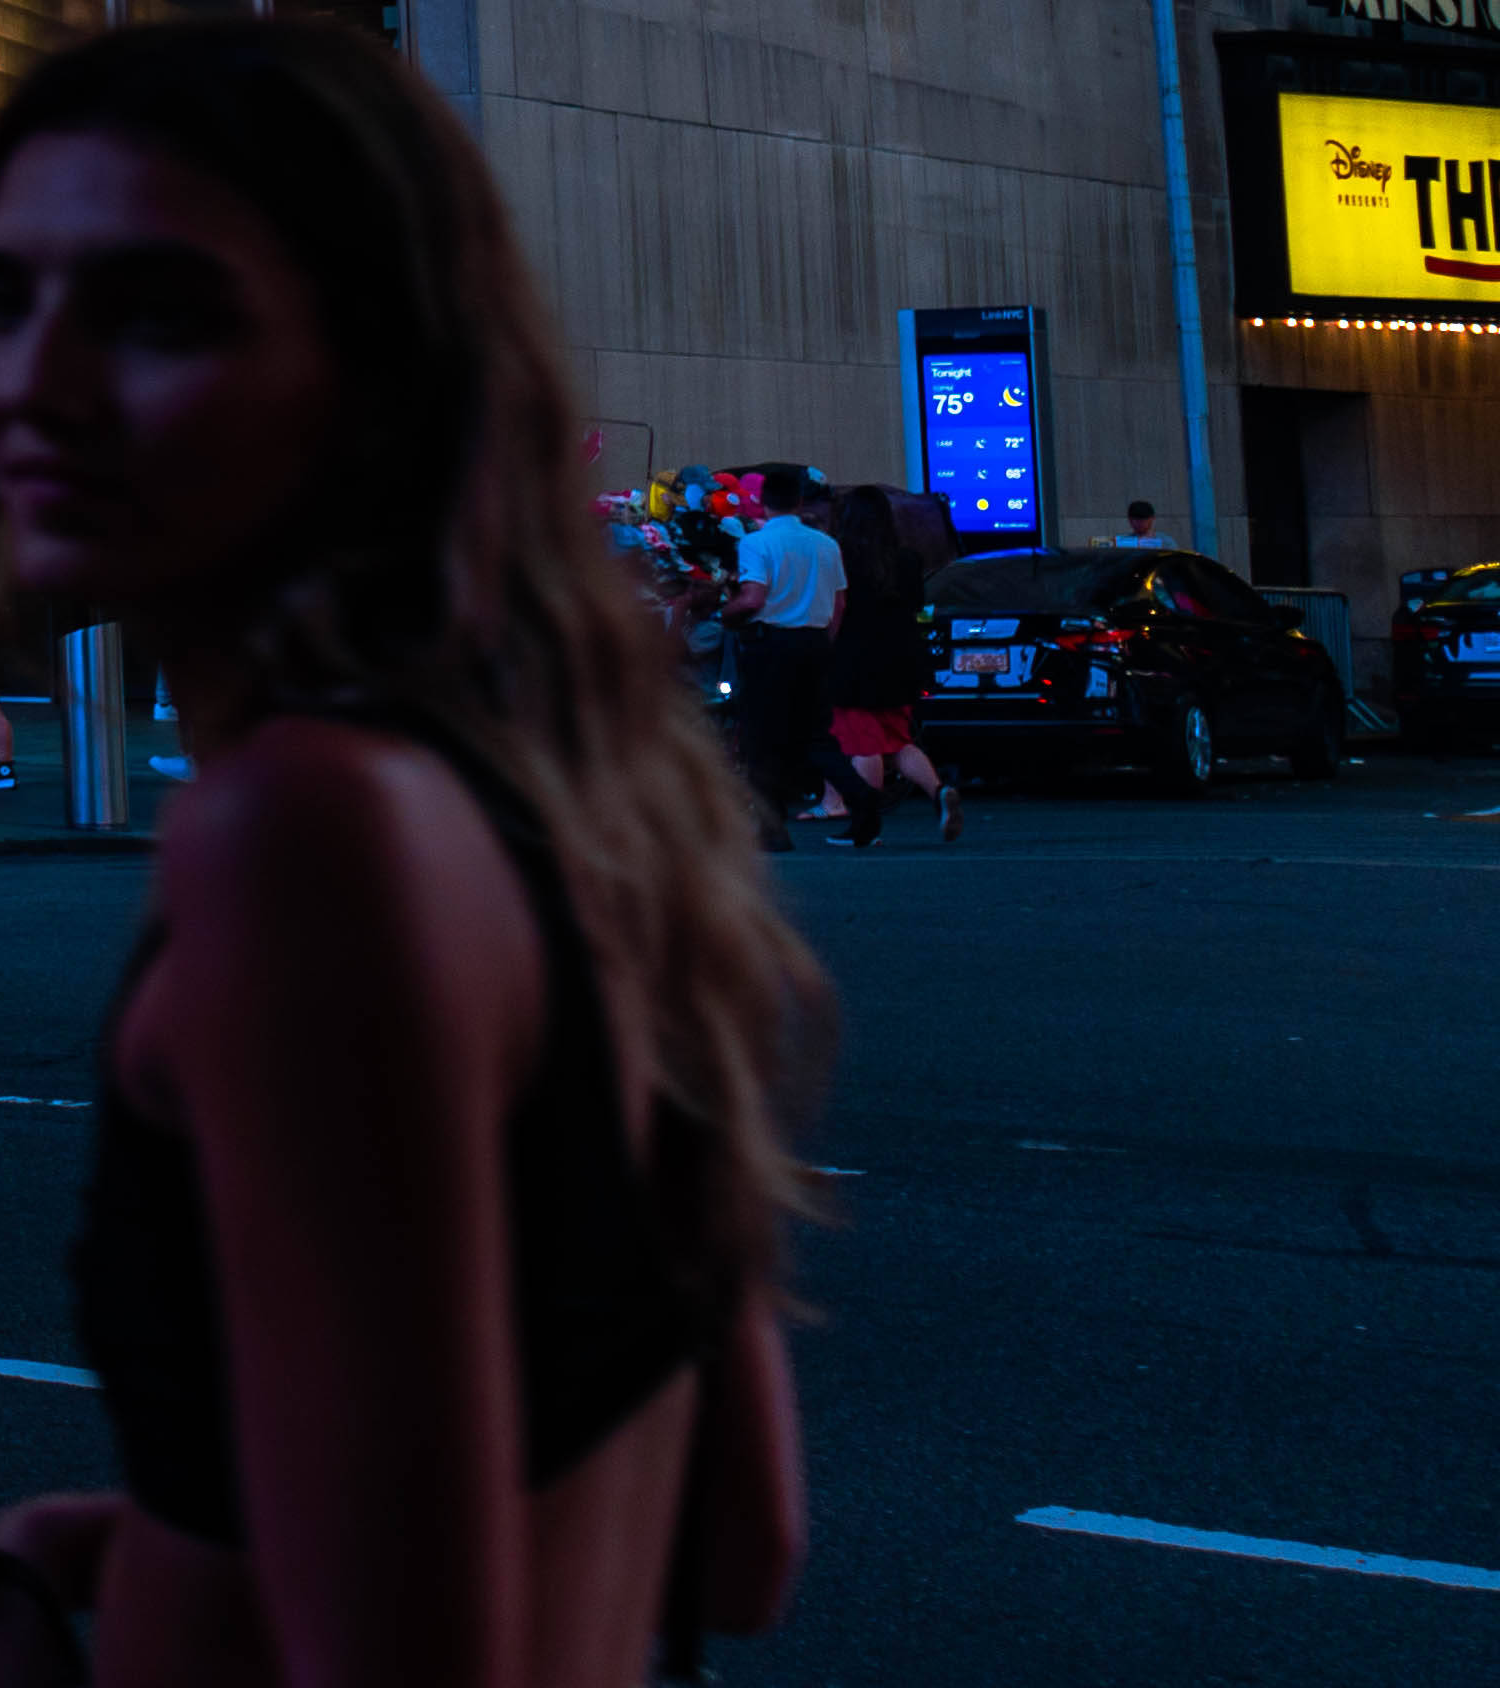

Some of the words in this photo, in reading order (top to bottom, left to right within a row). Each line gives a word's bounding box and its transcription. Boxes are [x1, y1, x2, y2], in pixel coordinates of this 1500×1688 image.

[1337, 194, 1389, 208] PRESENTS
[931, 368, 972, 379] Tonight
[932, 392, 974, 415] 75°
